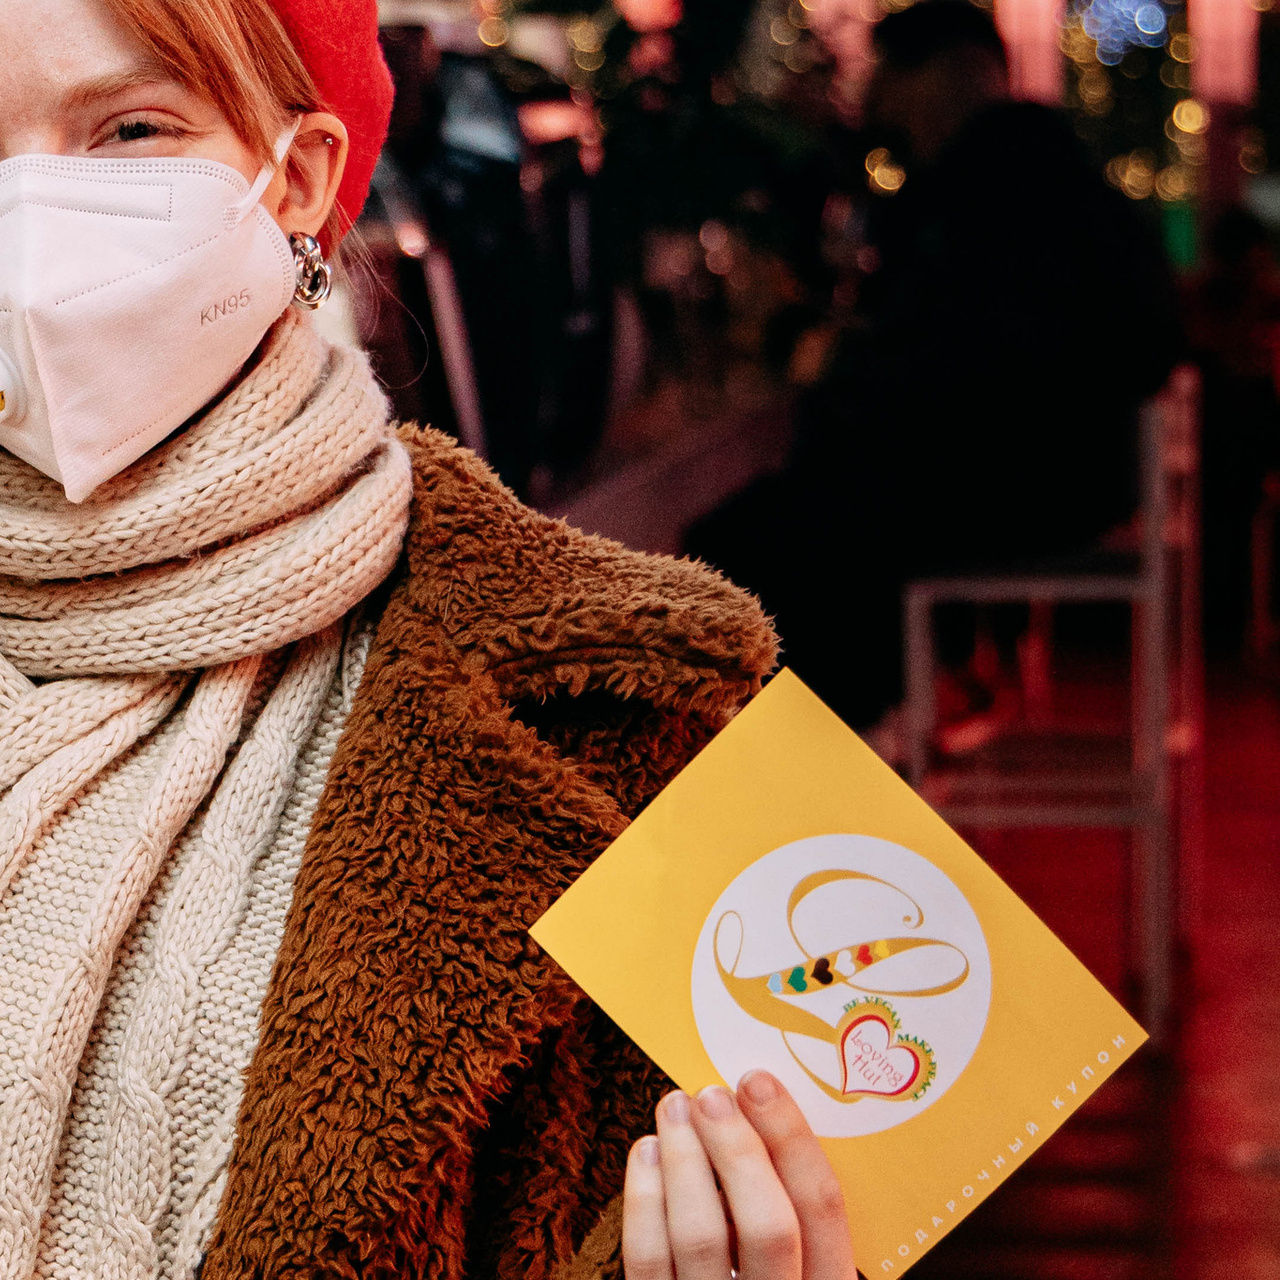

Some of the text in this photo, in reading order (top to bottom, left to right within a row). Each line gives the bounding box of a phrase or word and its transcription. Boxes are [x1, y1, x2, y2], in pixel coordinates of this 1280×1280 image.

[199, 288, 252, 327] KN95
[850, 1029, 904, 1089] Loving
[881, 1034, 1127, 1272] ПОДАРОЧНЫЙ КУПОН
